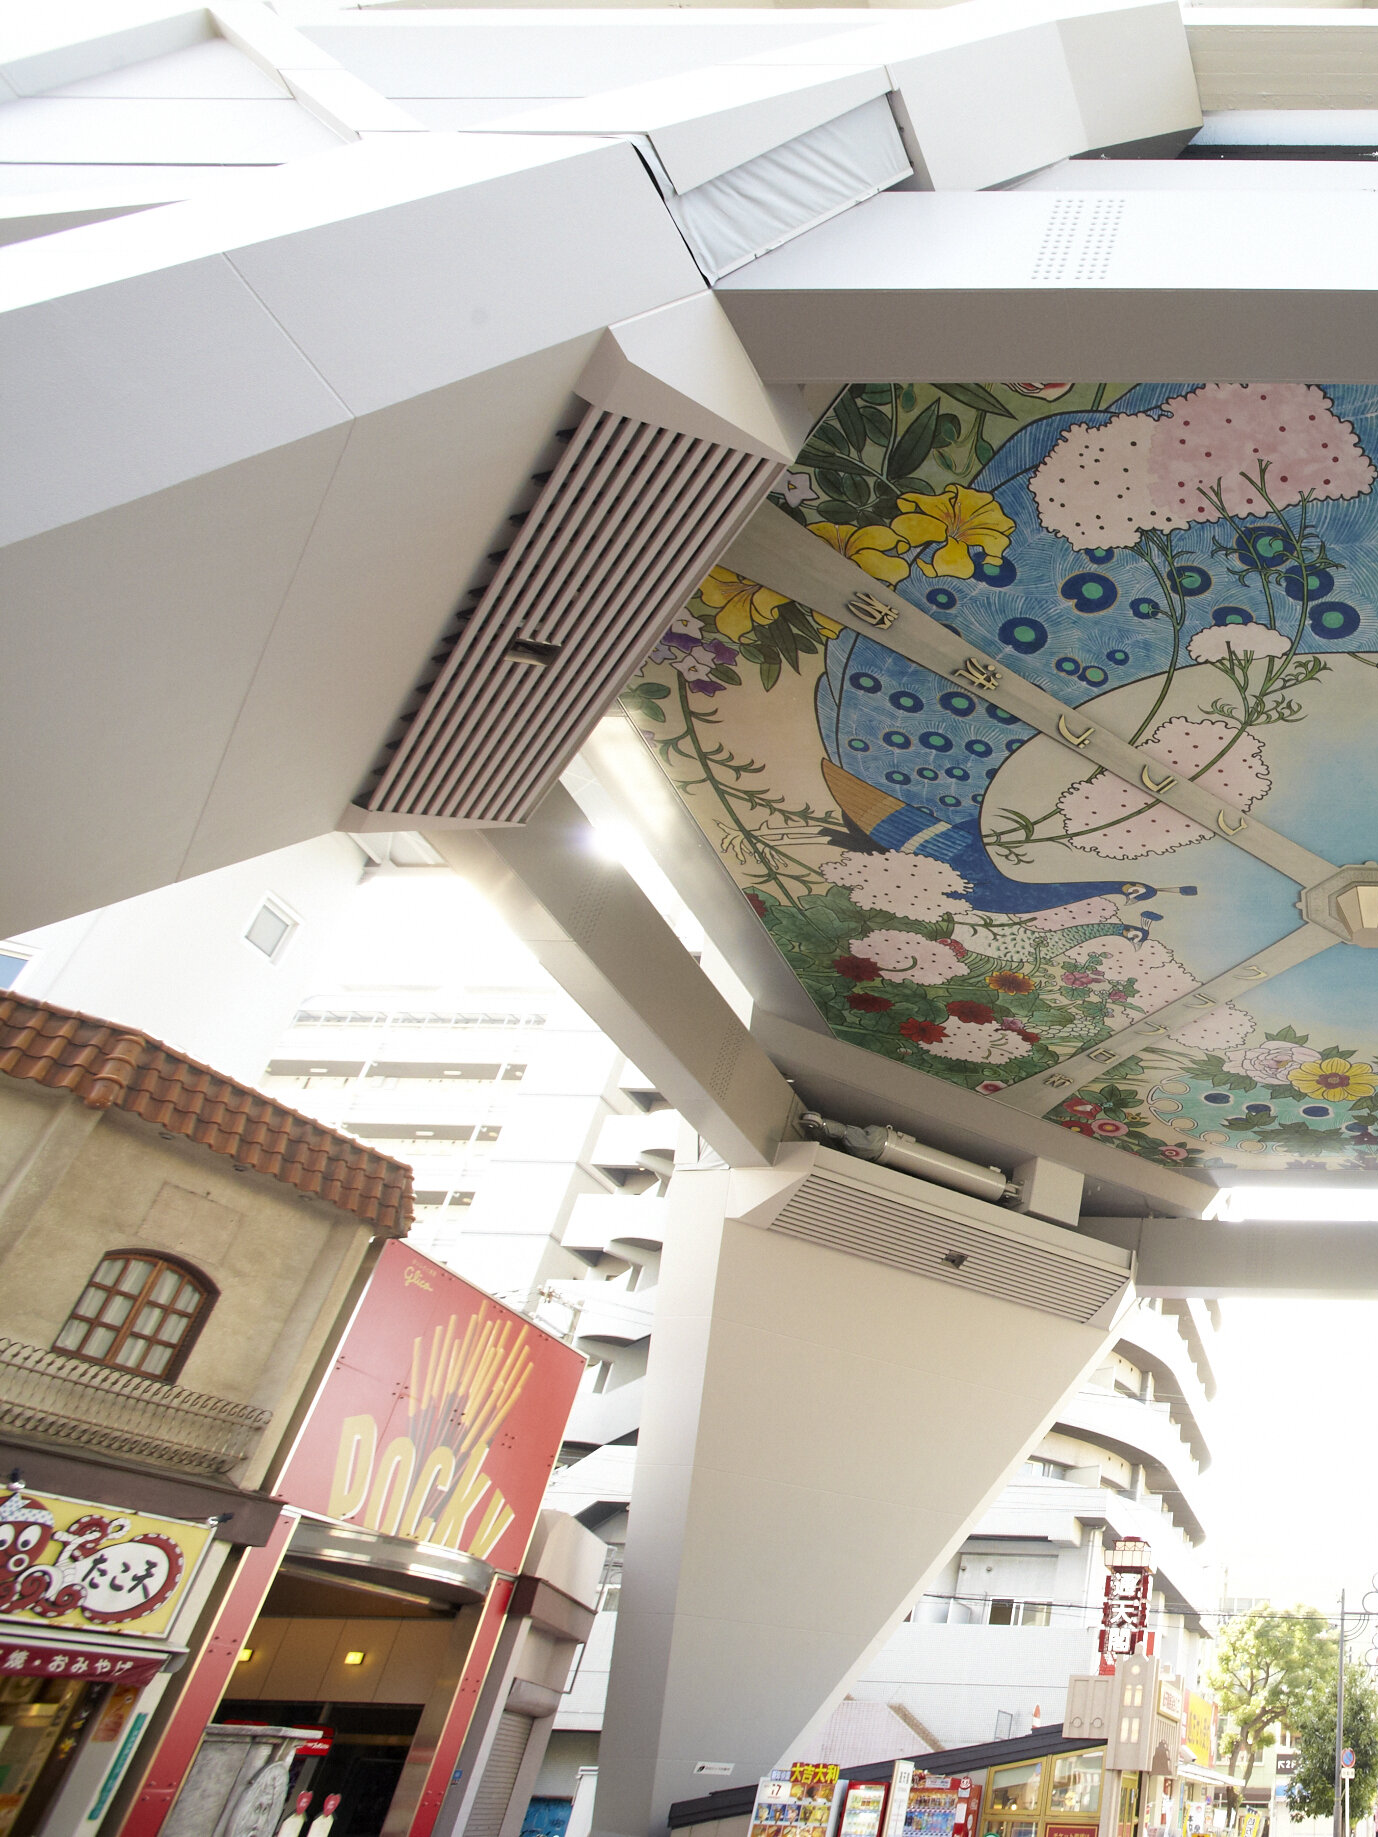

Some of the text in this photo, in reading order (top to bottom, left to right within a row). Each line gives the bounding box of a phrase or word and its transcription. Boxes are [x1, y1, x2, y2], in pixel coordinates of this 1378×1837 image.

[404, 1266, 433, 1291] Glico
[1108, 1572, 1142, 1653] 通天閣
[790, 1762, 840, 1785] 大吉大利
